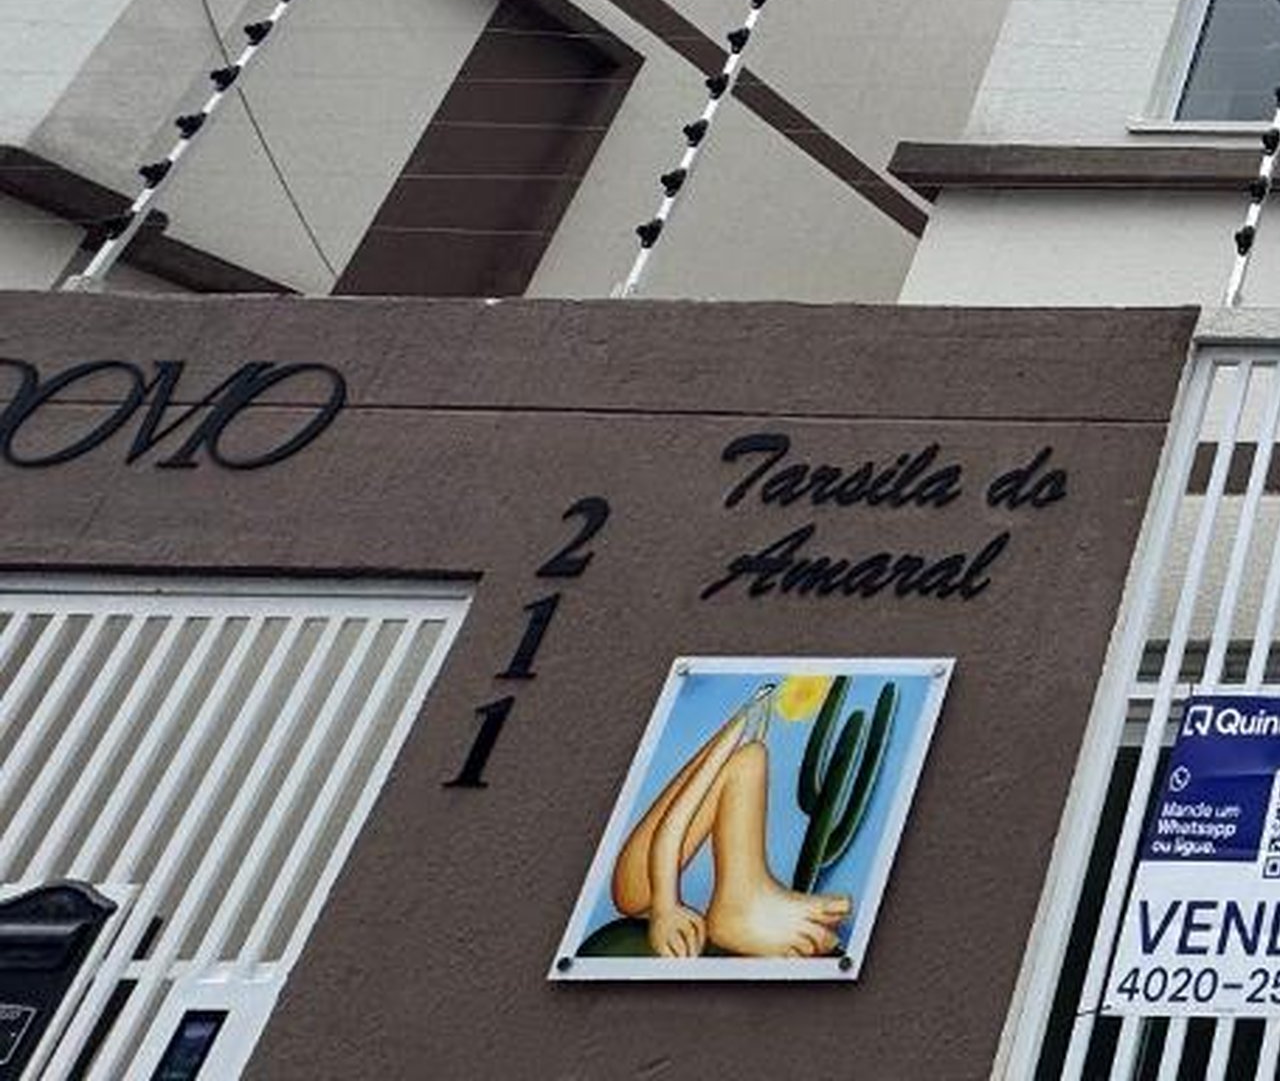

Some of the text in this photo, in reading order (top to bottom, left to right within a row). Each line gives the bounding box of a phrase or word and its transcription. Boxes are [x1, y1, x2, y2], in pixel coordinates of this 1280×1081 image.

[722, 433, 1067, 508] Tarsila do
[701, 524, 1011, 600] Amaral
[1160, 802, 1240, 818] Mande um
[1151, 840, 1172, 853] ou
